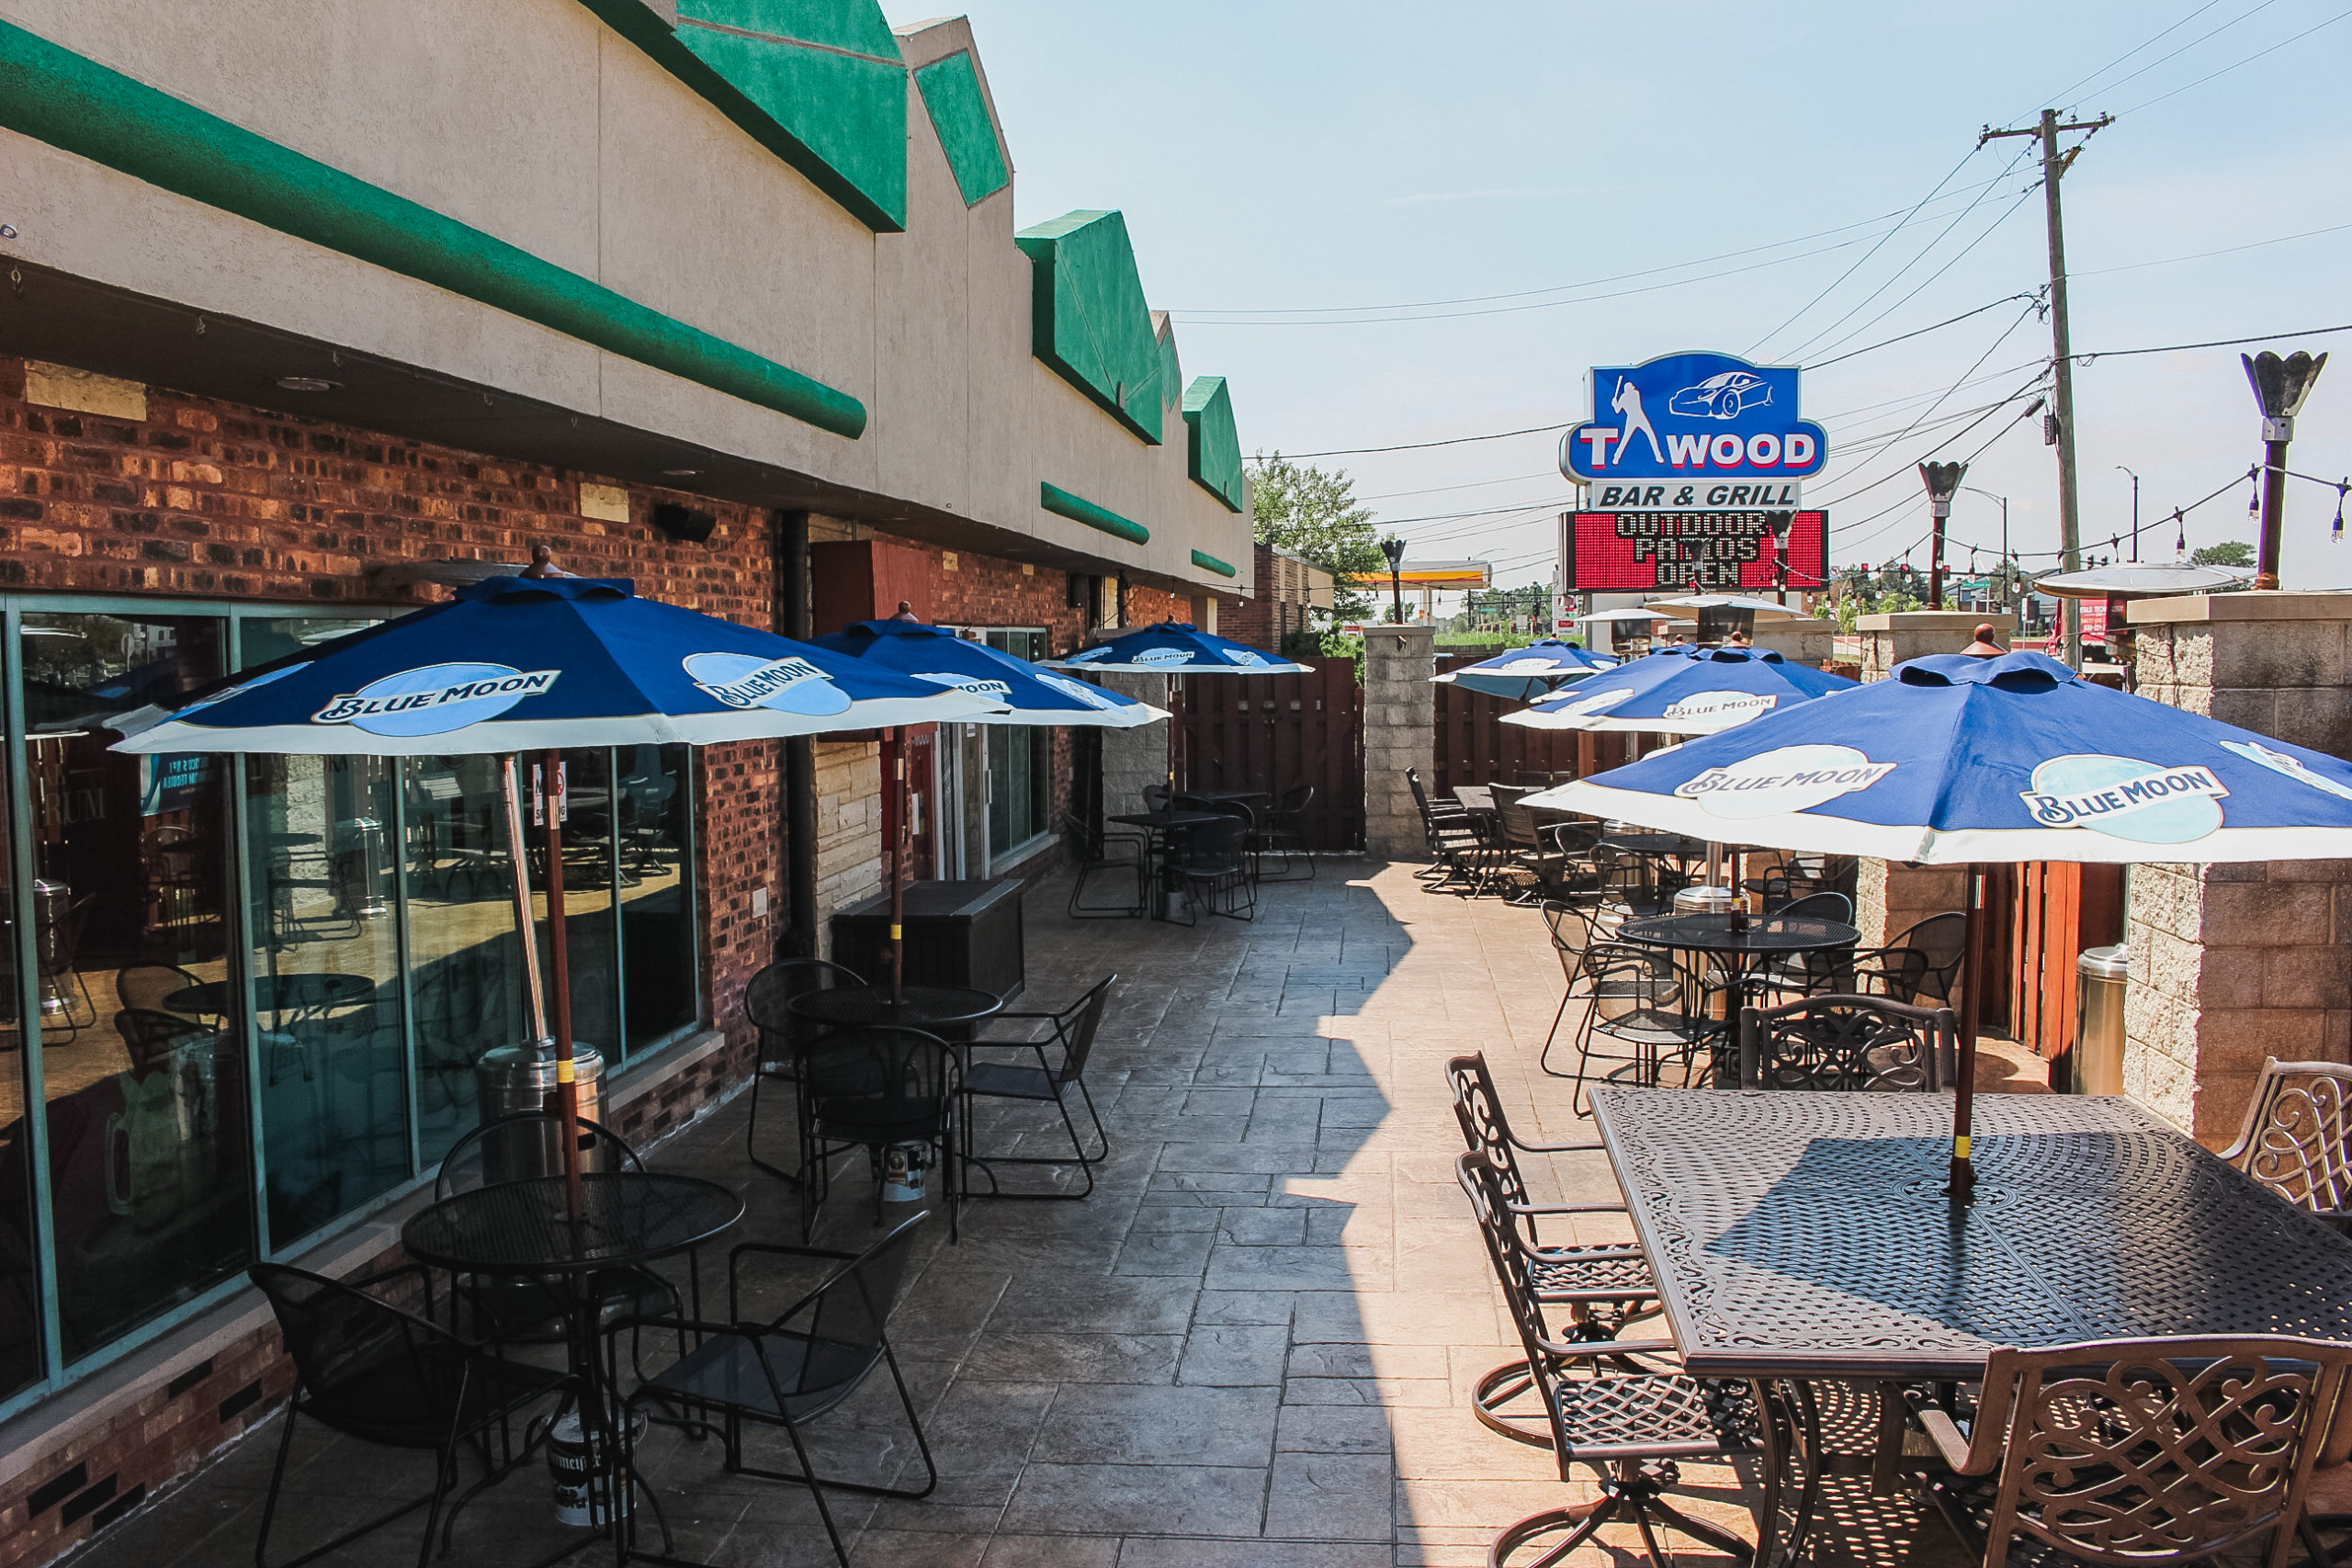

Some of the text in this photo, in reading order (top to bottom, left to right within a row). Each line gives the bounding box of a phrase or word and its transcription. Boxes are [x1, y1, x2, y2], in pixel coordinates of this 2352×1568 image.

[1600, 485, 1795, 506] BAR & GRILL
[1617, 513, 1766, 536] OUTDOOR
[1133, 651, 1193, 663] BLUE MOON
[707, 661, 819, 706] BLUE MOON
[319, 674, 549, 720] BLUE MOON
[1667, 698, 1771, 716] BLUE MOON
[1681, 767, 1882, 794] BLUE MOON
[2034, 772, 2214, 823] BLUE MOON
